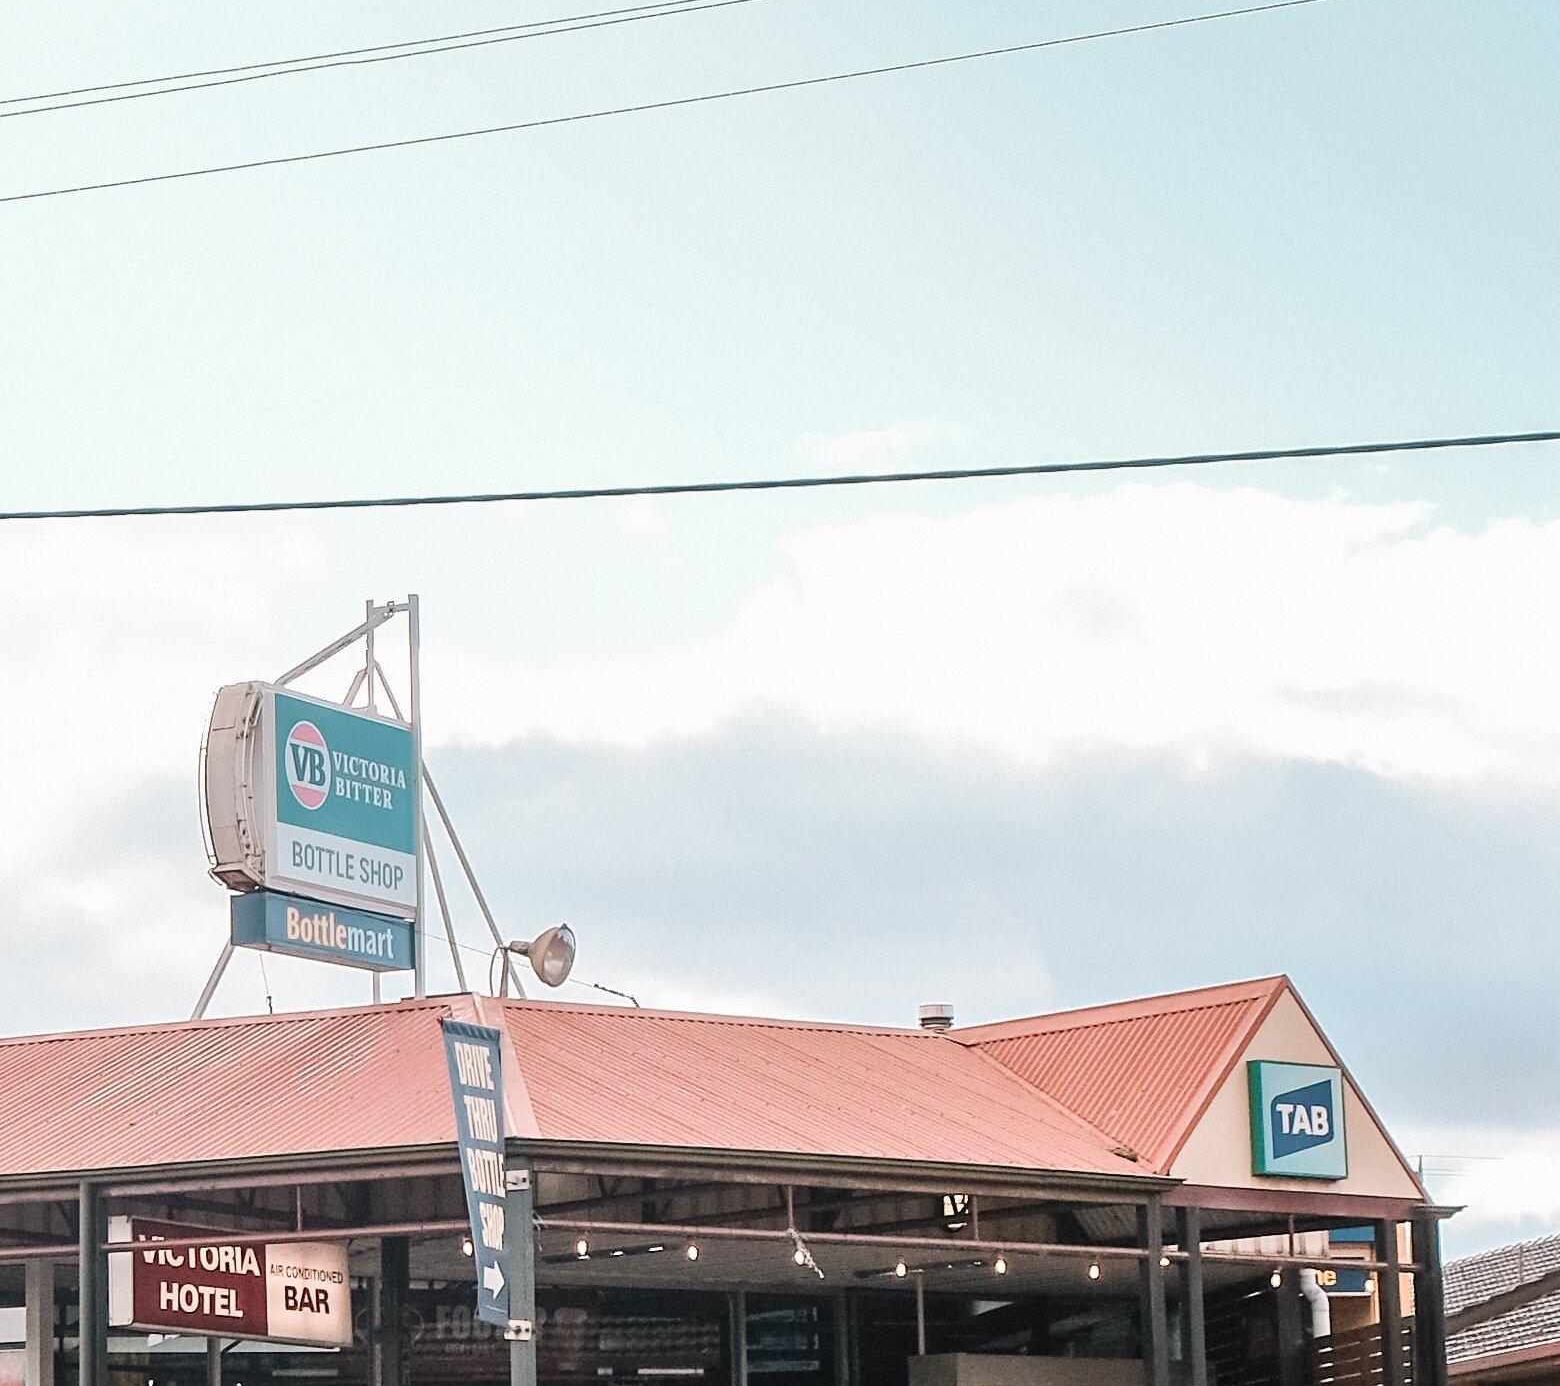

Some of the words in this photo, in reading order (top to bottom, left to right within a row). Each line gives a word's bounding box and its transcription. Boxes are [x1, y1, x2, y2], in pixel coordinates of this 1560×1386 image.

[289, 741, 327, 787] VB
[331, 749, 407, 790] VICTORIA
[334, 775, 394, 811] BITTER
[291, 839, 355, 882] BOTTLE
[359, 856, 405, 891] SHOP
[285, 905, 395, 960] Bottlemart
[453, 1041, 496, 1091] DRIVE
[463, 1094, 499, 1145] THRU
[1275, 1102, 1331, 1137] TAB
[466, 1148, 507, 1199] BOTTLE
[479, 1201, 505, 1252] SHOP
[269, 1263, 284, 1278] AIR
[285, 1265, 344, 1285] CONDITIONED
[159, 1281, 244, 1319] HOTEL
[284, 1285, 330, 1315] BAR
